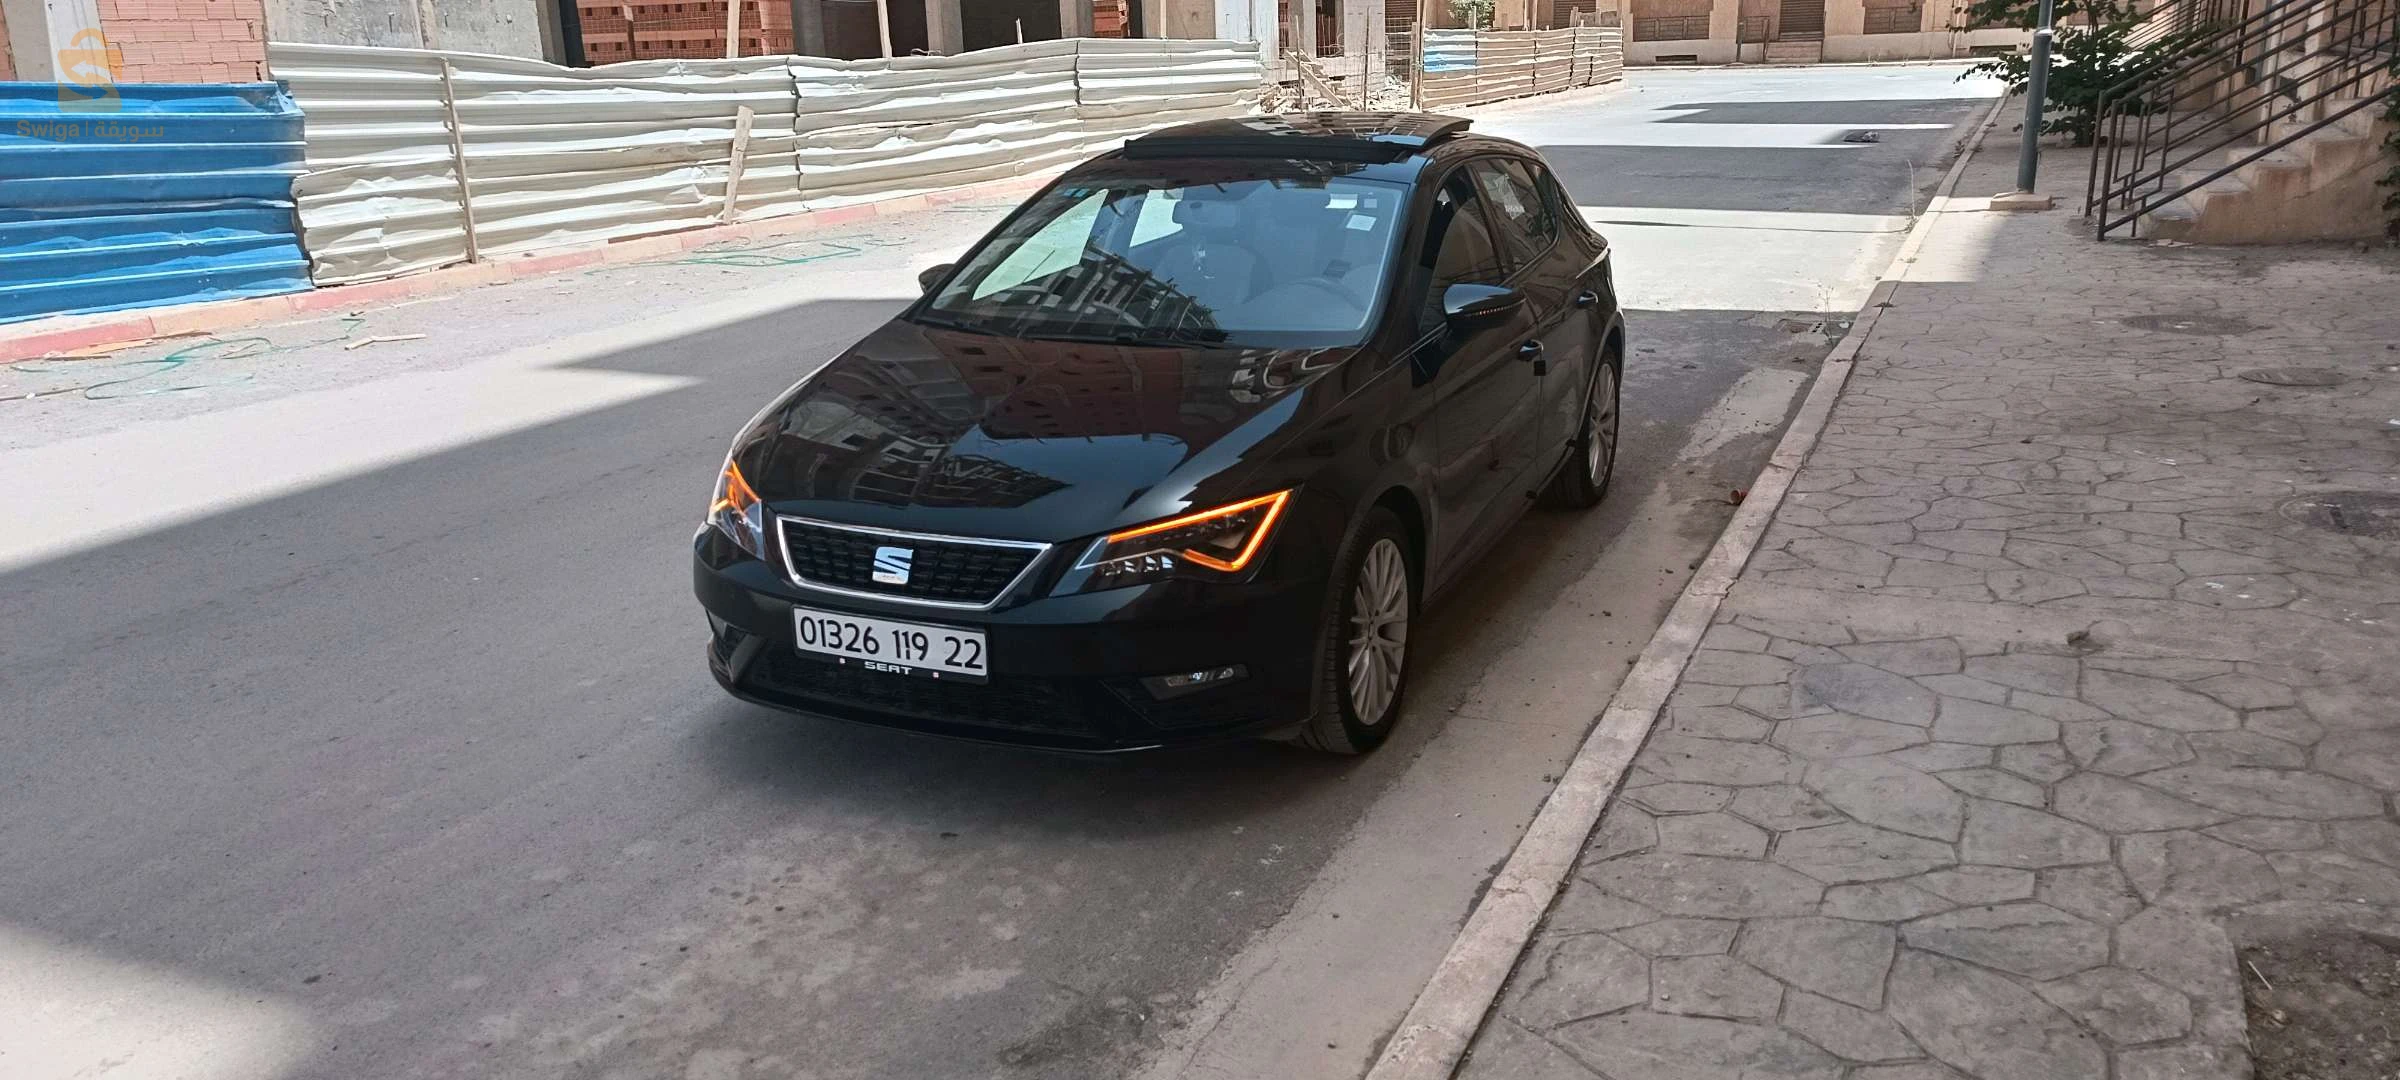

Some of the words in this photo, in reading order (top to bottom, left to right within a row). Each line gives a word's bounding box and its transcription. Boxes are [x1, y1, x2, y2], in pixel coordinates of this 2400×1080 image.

[800, 616, 880, 655] 01326
[892, 629, 929, 661] 119
[944, 636, 983, 670] 22
[864, 661, 913, 675] SEAT
